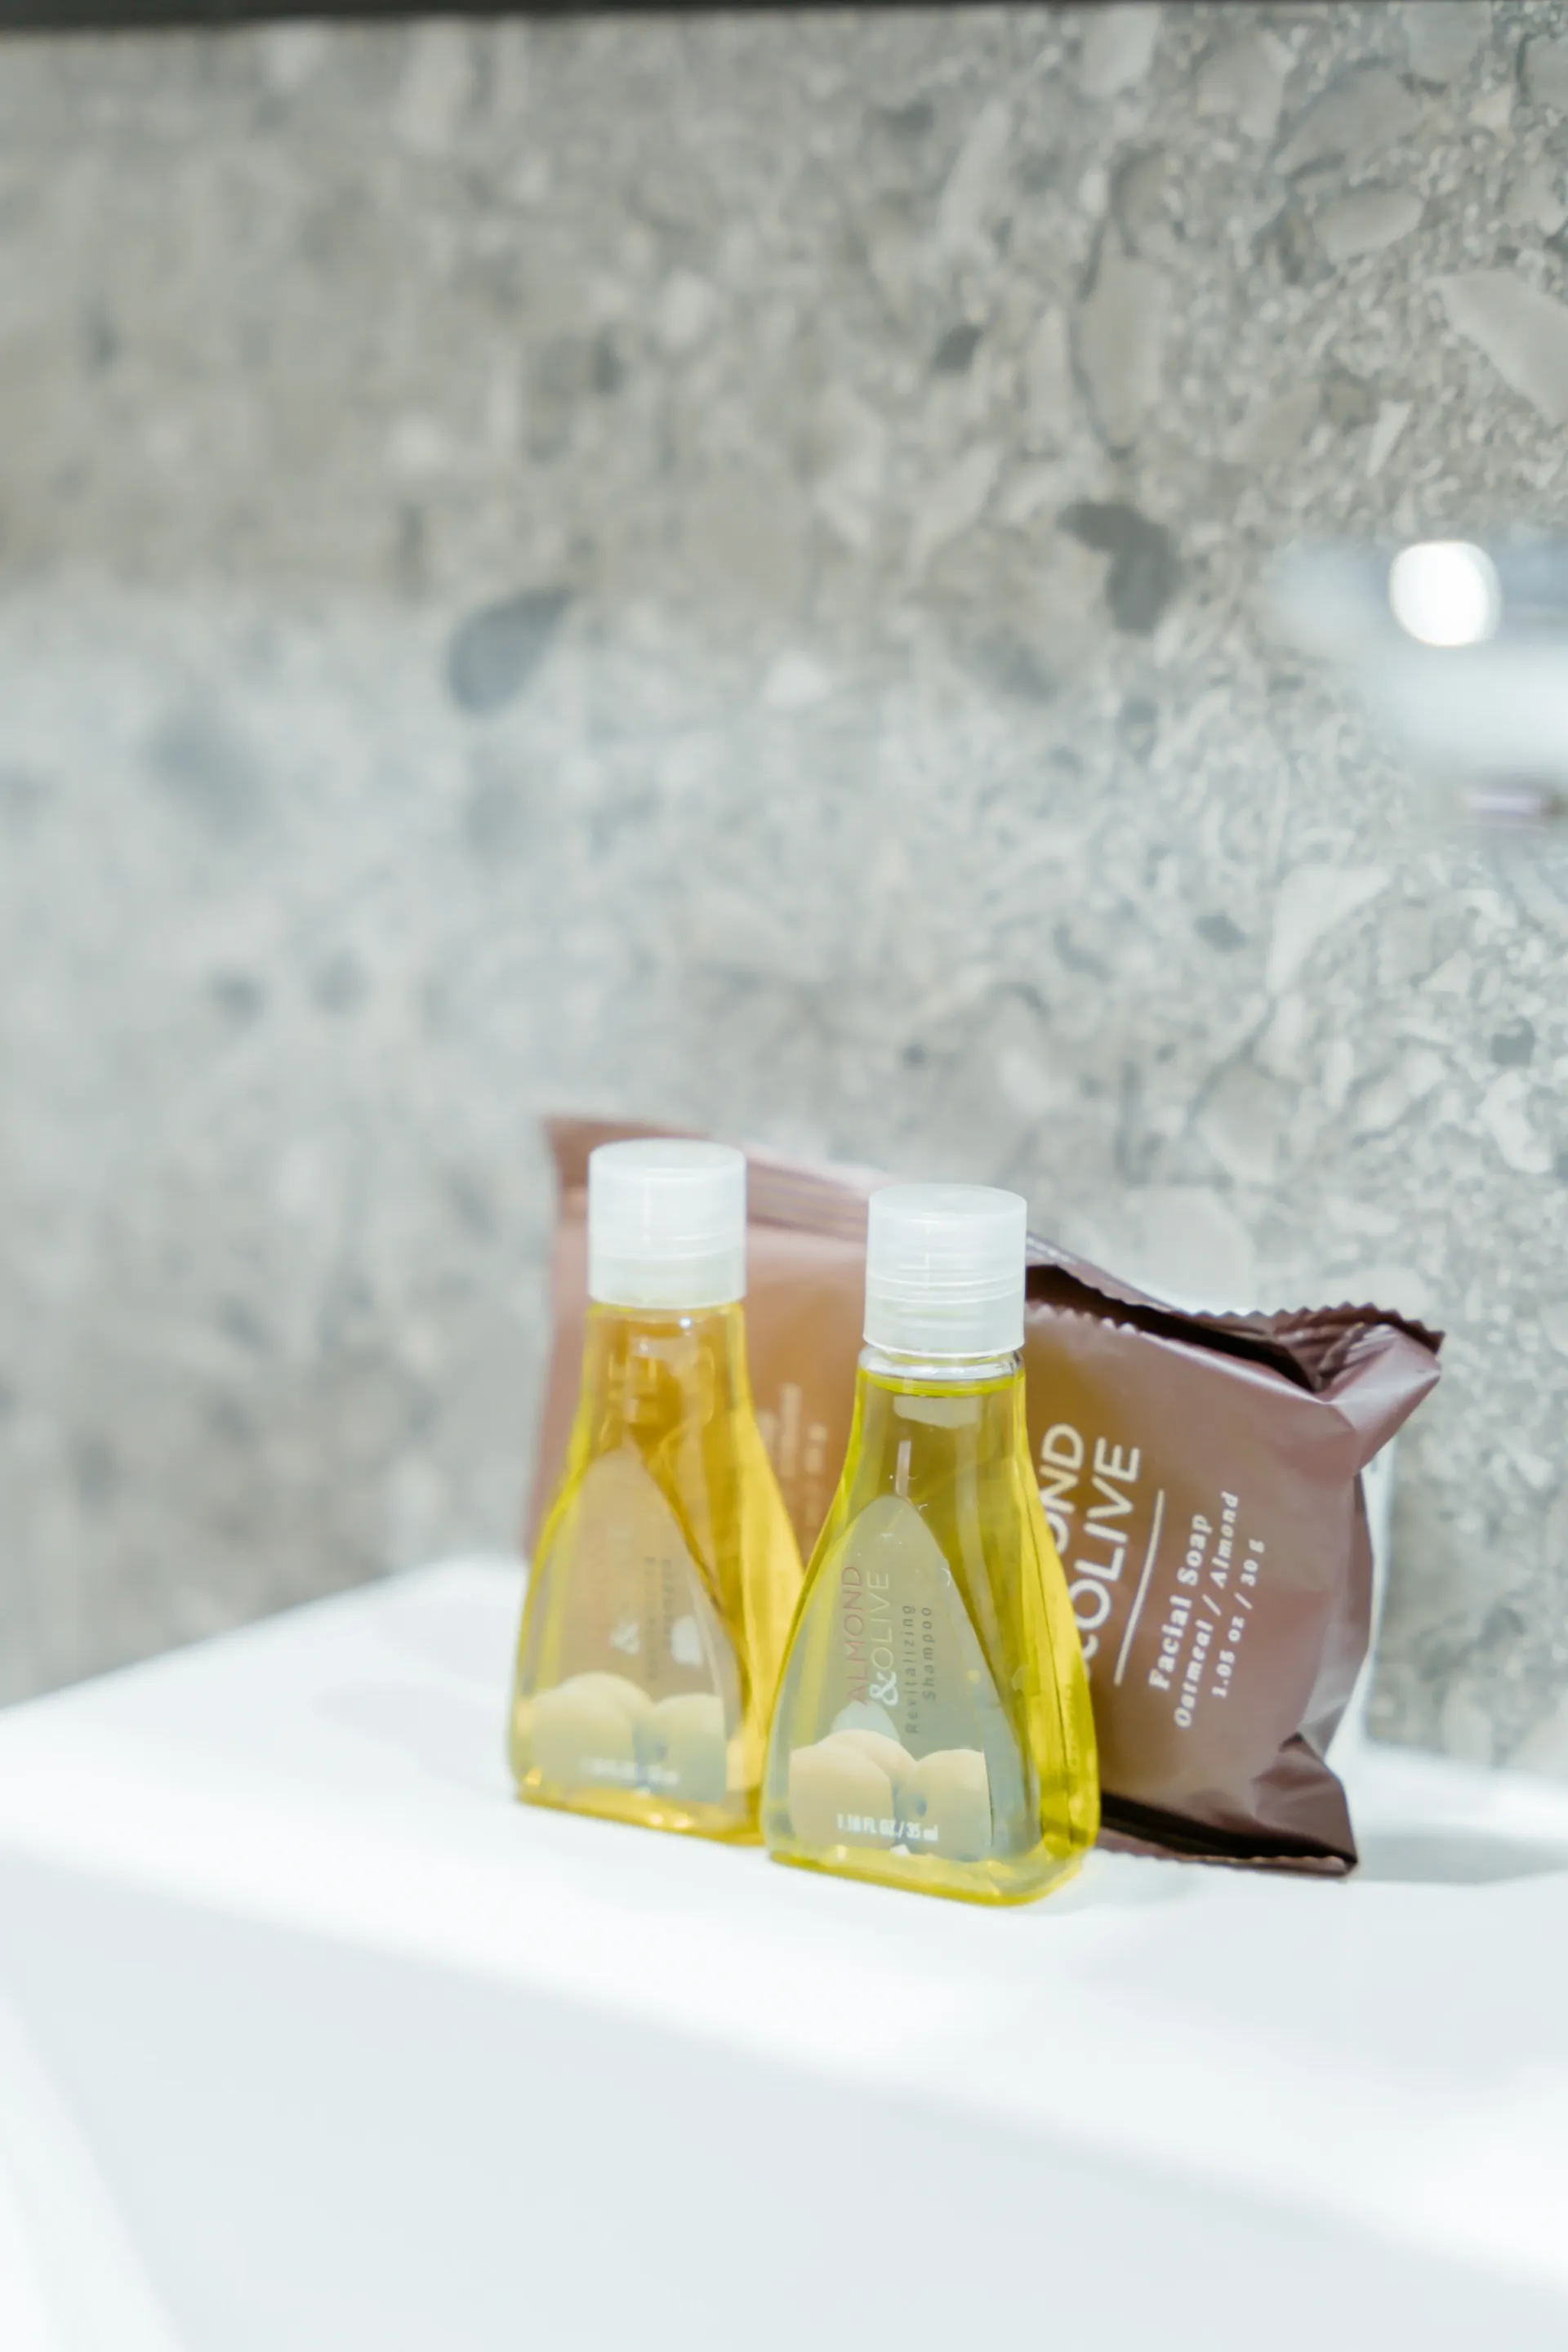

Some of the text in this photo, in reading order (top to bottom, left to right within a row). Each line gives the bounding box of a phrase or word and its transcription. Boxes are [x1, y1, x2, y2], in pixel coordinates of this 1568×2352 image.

[1148, 1514, 1213, 1690] Facial Soap
[1174, 1490, 1239, 1728] Oatmeal / Almond
[1234, 1592, 1253, 1610] /
[1240, 1558, 1258, 1587] 30
[842, 1566, 867, 1706] ALMOND
[901, 1605, 919, 1734] Revitalizing
[921, 1607, 936, 1701] Shampoo
[1211, 1649, 1236, 1698] 1.05
[1227, 1615, 1245, 1642] oz
